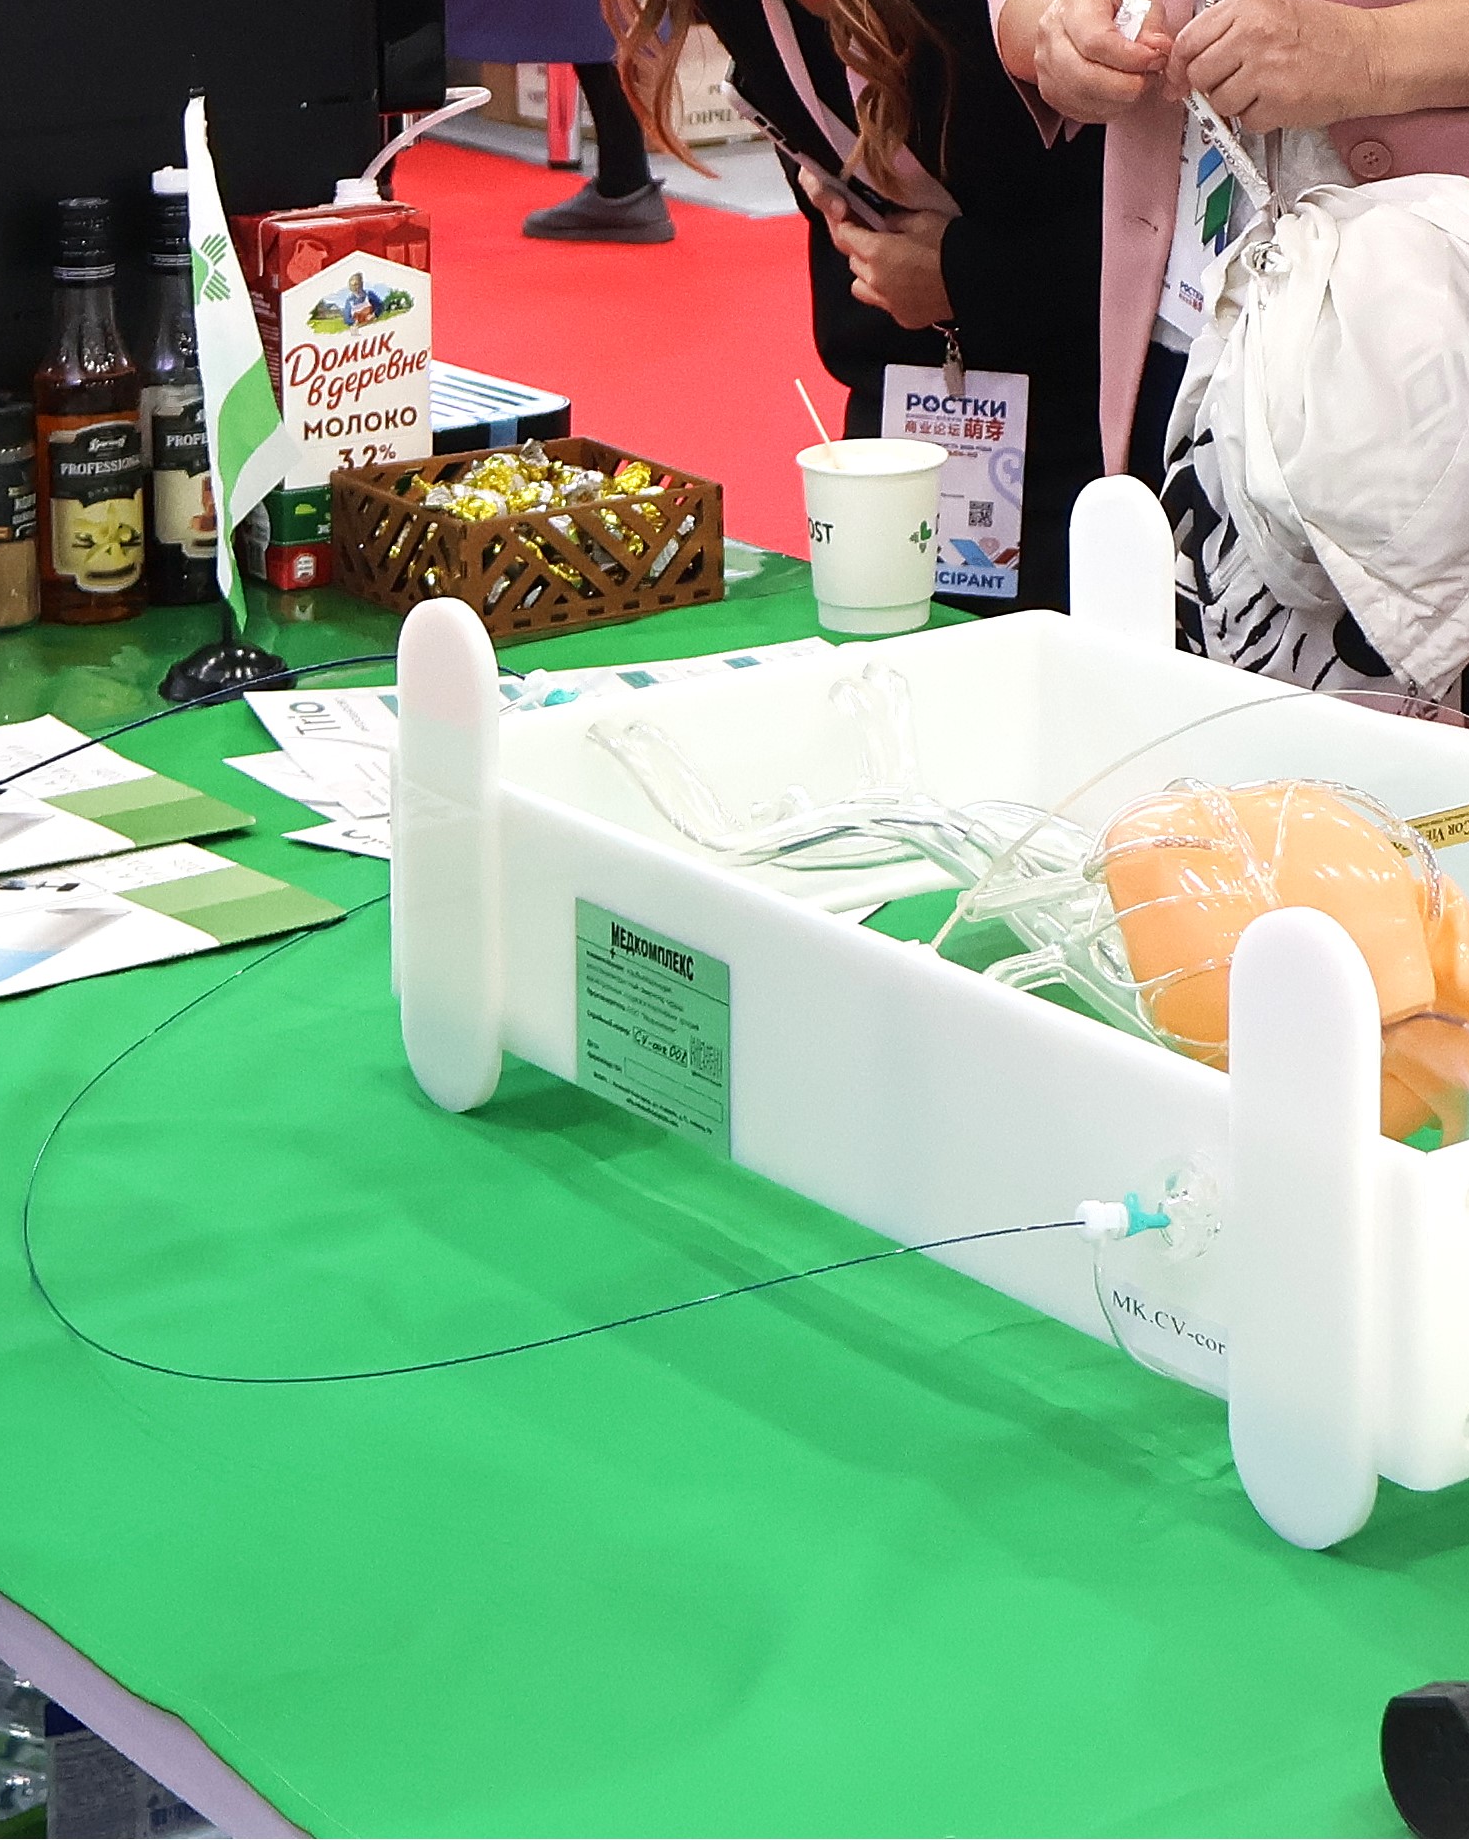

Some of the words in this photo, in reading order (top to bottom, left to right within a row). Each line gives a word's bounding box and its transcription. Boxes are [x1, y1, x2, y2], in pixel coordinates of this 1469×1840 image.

[285, 331, 395, 388] Домик
[327, 346, 429, 410] деревне
[303, 406, 418, 441] МОЛОКО
[906, 393, 1007, 418] РОСТКИ
[611, 921, 695, 982] МЕДКОМПЛЕКС
